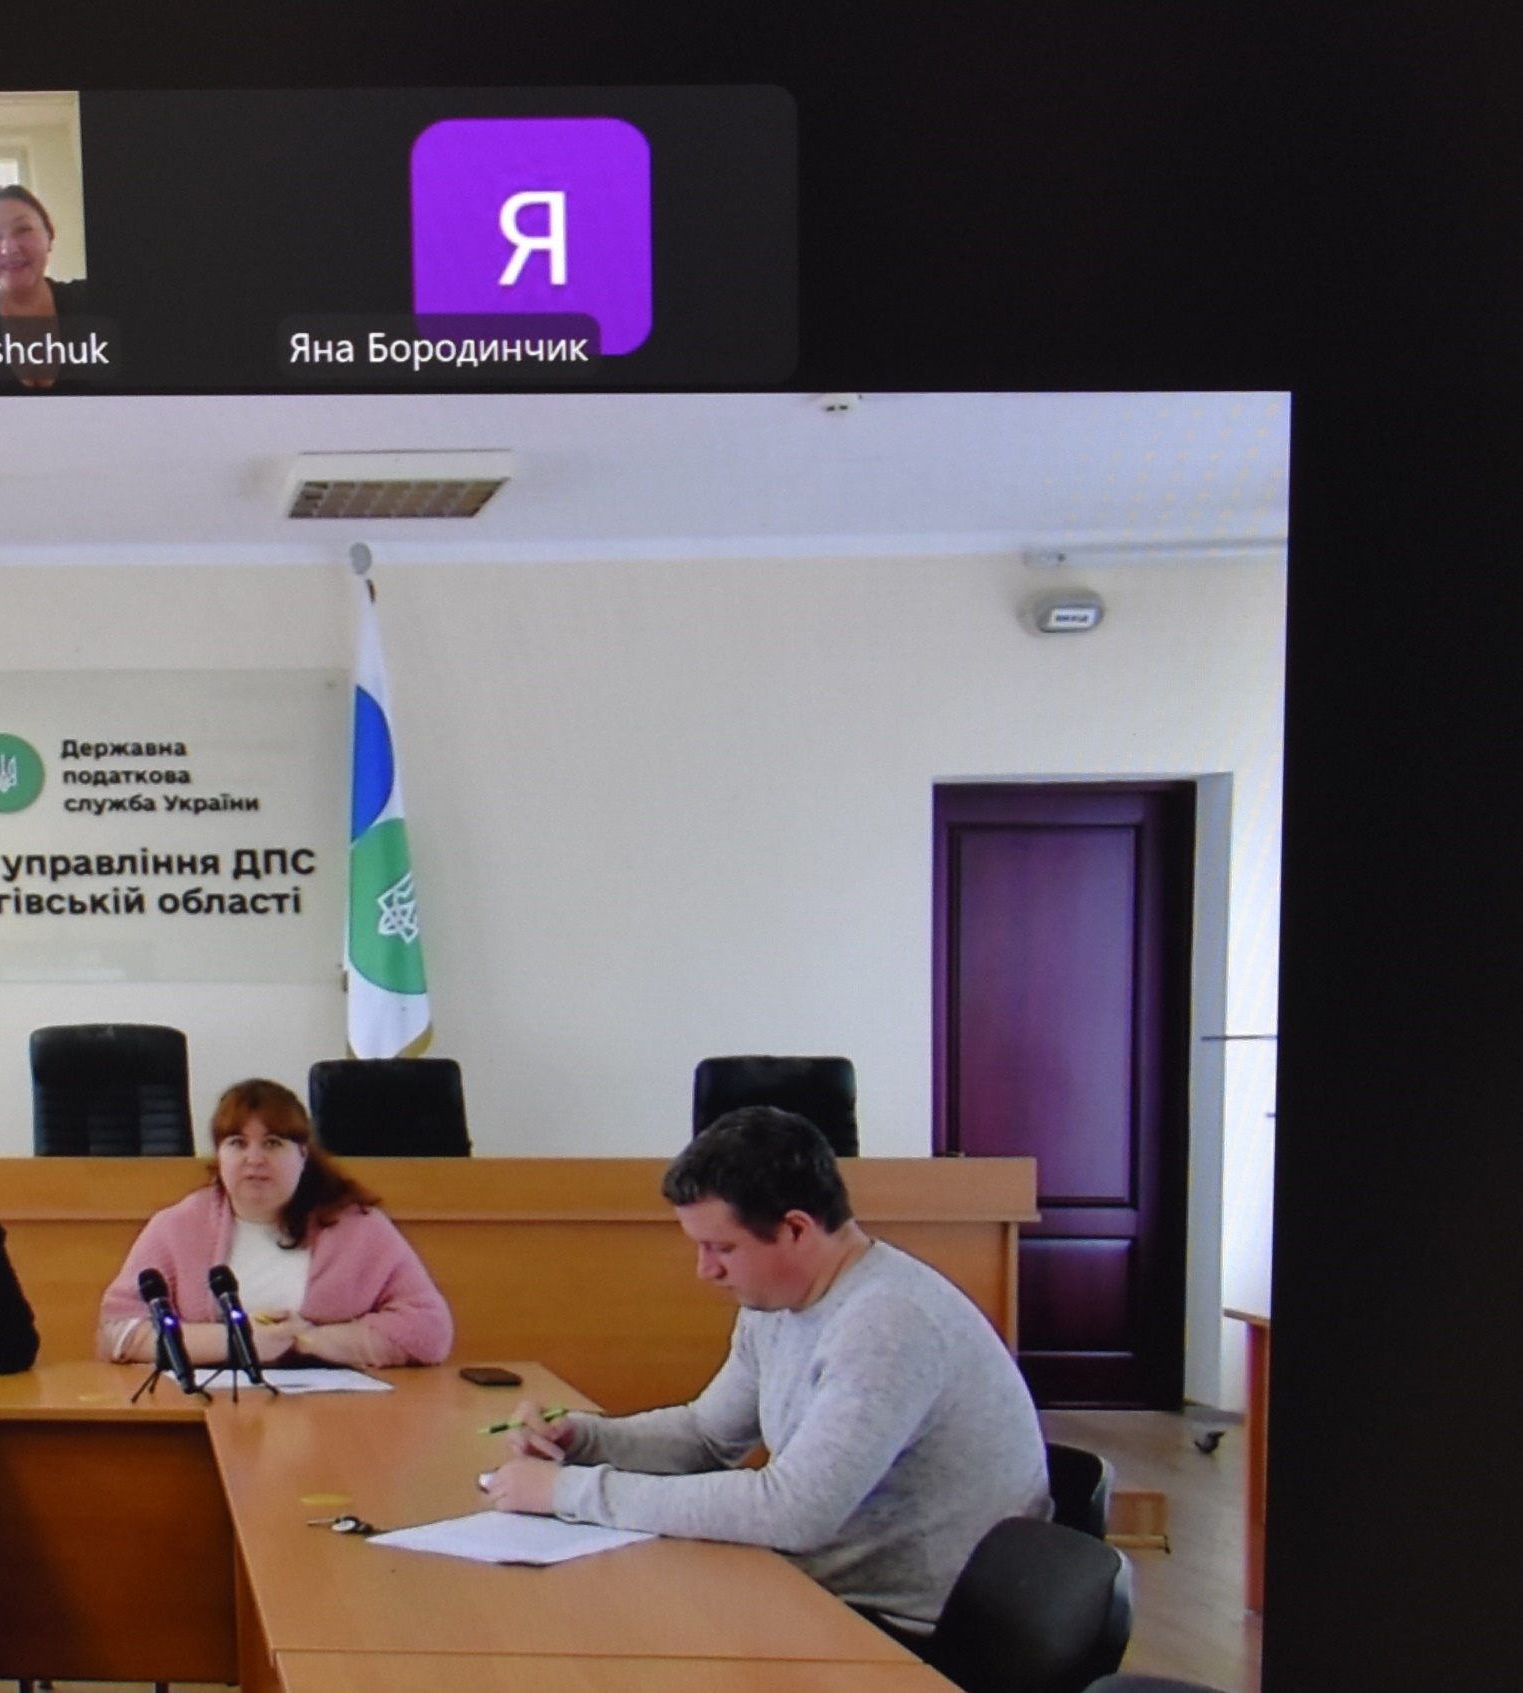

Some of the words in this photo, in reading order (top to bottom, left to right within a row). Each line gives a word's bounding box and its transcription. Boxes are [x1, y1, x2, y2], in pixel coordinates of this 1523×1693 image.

[498, 190, 568, 286] Я
[289, 333, 355, 363] Яна
[368, 332, 589, 371] Бородинчик
[61, 739, 187, 760] Державна
[62, 768, 192, 788] податкова
[63, 795, 157, 815] служба
[164, 793, 261, 815] України
[1, 848, 221, 882] управління
[232, 847, 317, 880] ДПС
[157, 886, 303, 916] області
